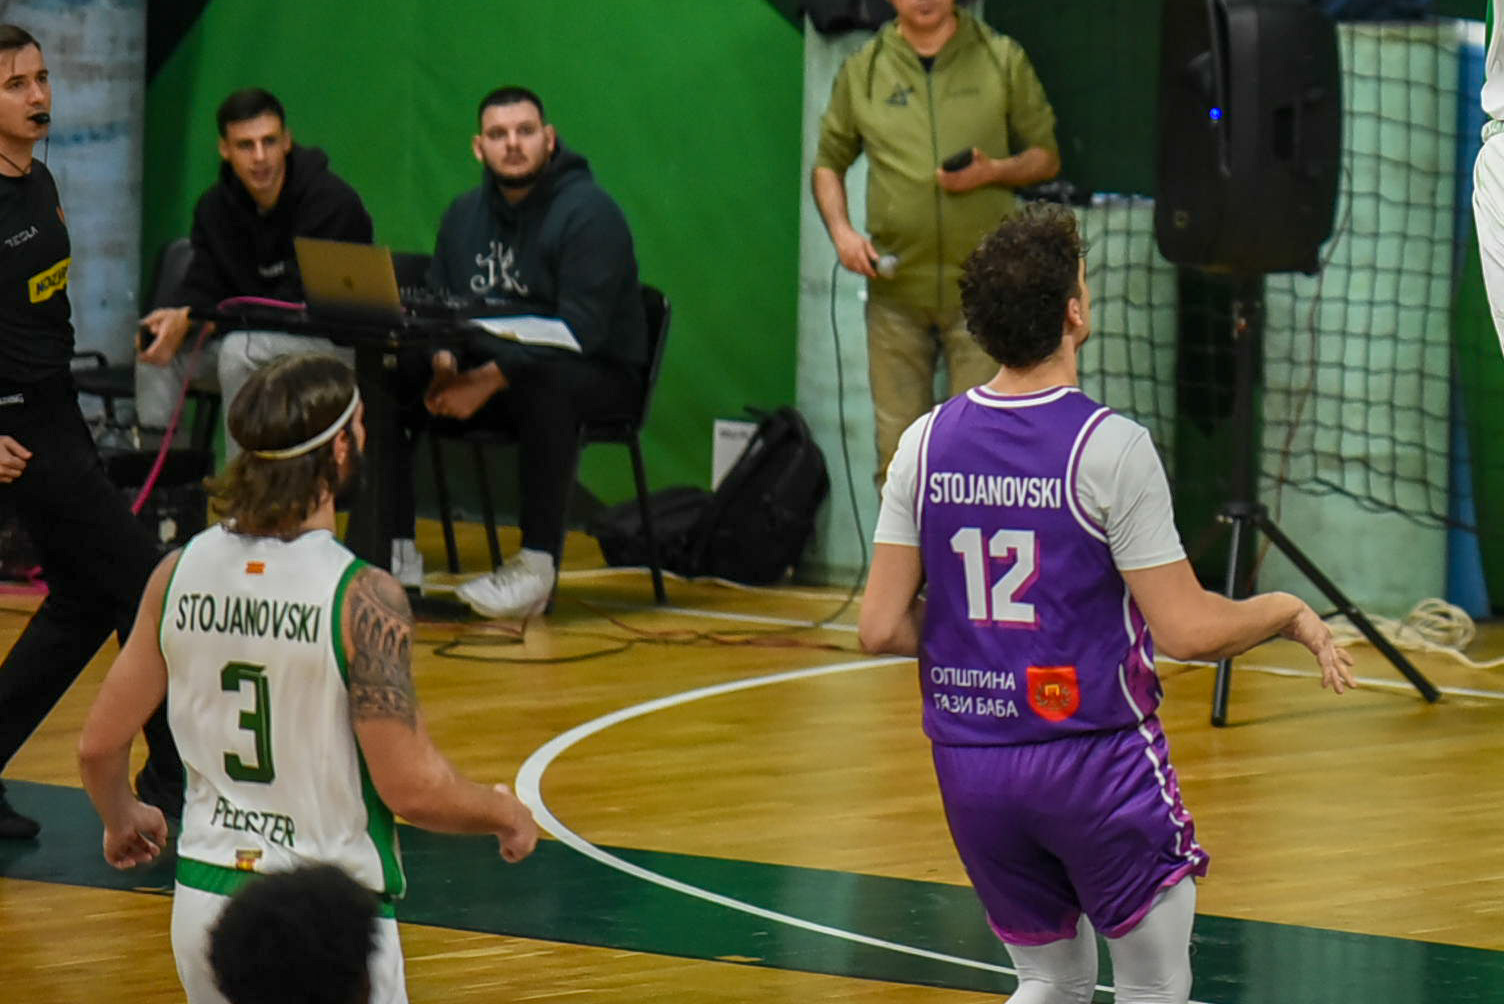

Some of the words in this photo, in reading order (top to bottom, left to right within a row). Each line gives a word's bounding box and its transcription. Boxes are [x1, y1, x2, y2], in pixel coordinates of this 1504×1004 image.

[930, 472, 1062, 509] STOJANOVSKI
[950, 527, 1038, 627] 12
[176, 593, 321, 644] STOJANOVSKI
[930, 666, 1016, 691] ОПШТИНА
[221, 661, 276, 784] 3
[976, 697, 1019, 718] БАБА
